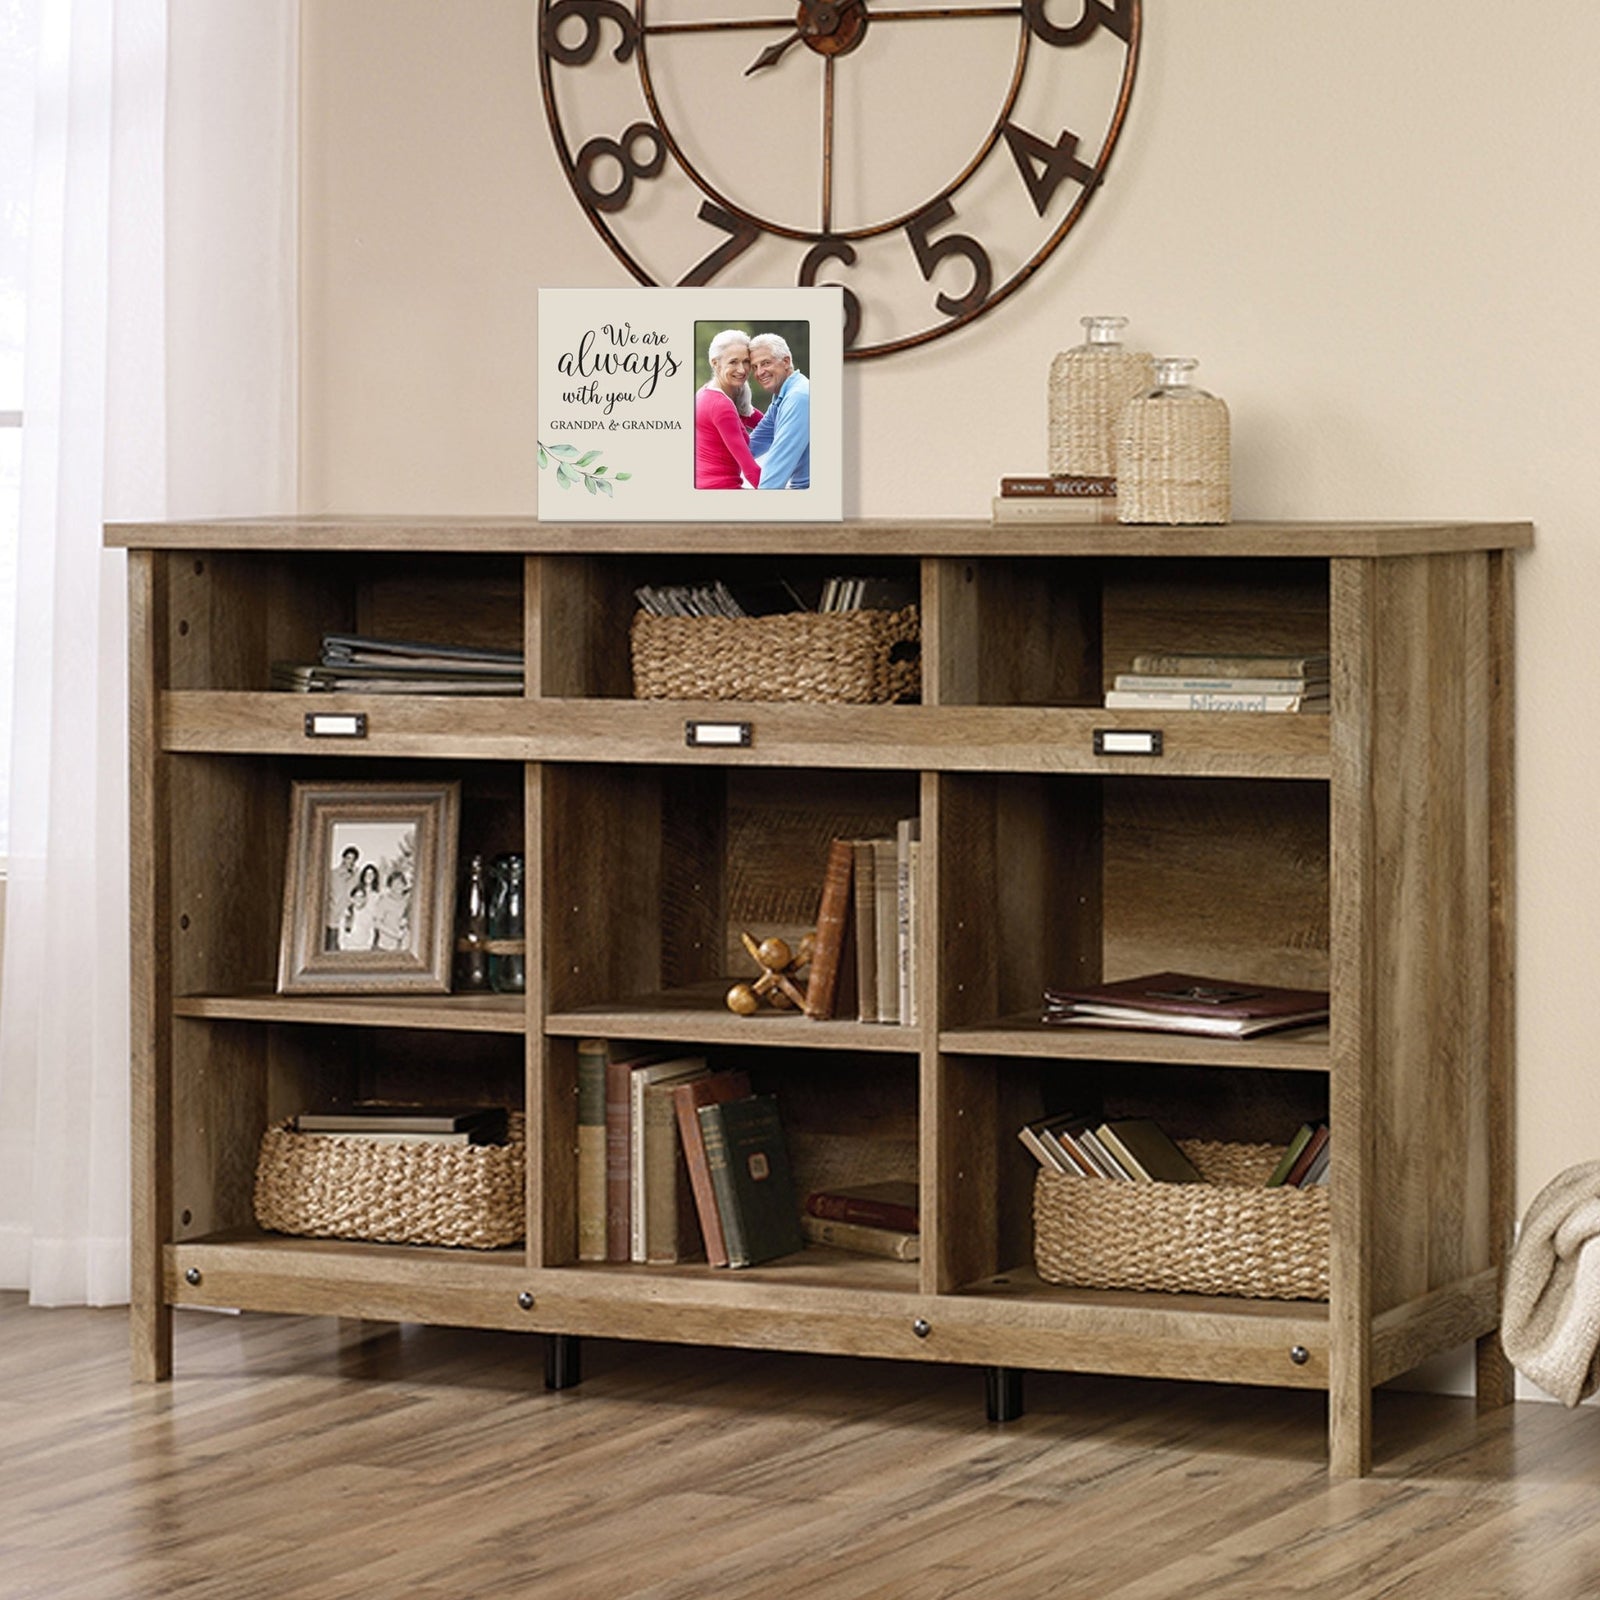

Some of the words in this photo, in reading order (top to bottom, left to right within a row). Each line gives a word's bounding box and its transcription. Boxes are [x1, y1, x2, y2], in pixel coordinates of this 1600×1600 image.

[575, 122, 666, 213] 8
[1001, 119, 1104, 218] 4
[674, 199, 761, 288] 7
[904, 199, 993, 319] 5
[557, 329, 683, 400] always
[600, 321, 640, 348] We
[642, 330, 670, 346] are
[550, 420, 605, 431] GRANDPA
[608, 418, 620, 432] &
[622, 420, 682, 431] GRANDMA
[562, 380, 603, 405] with
[602, 391, 636, 415] you
